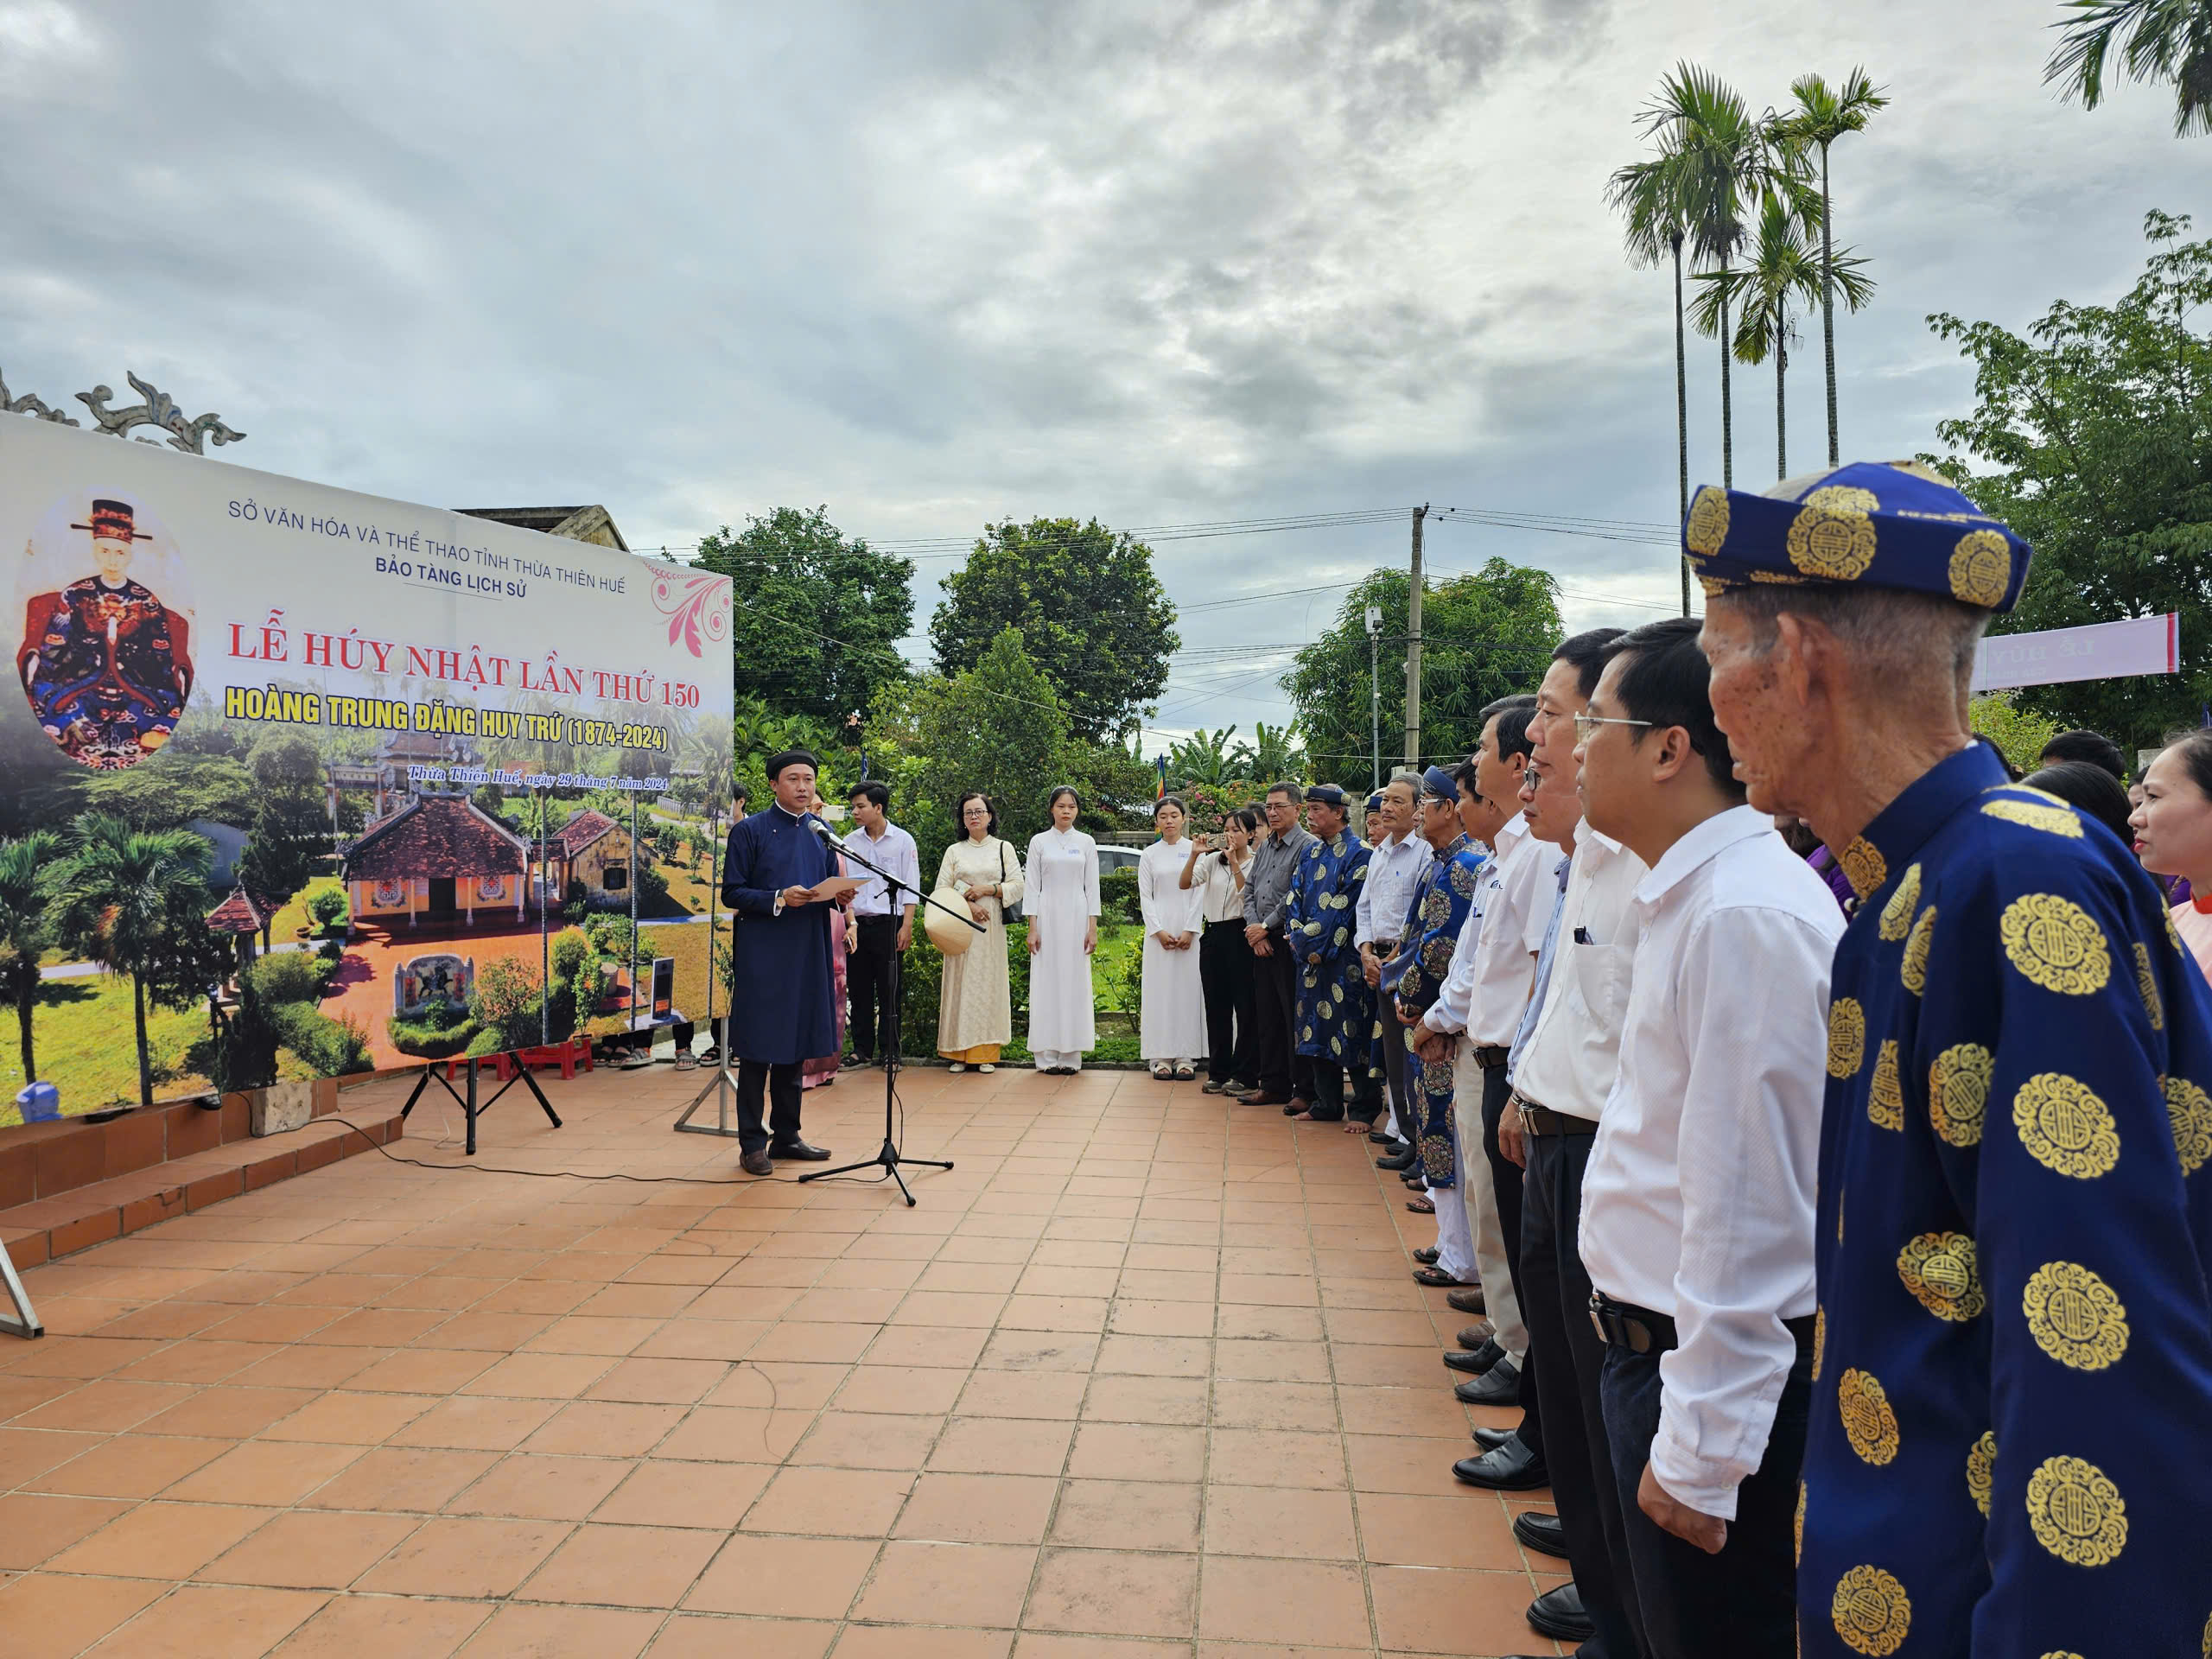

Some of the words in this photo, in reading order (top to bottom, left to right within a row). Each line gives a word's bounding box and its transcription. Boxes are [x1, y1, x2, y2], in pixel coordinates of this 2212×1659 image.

[228, 499, 257, 520] SỞ
[264, 507, 304, 530] VĂN
[311, 517, 350, 539] HÓA
[356, 525, 379, 544] VÀ
[386, 531, 420, 552] THỂ
[425, 540, 470, 562] THAO
[474, 547, 509, 570] TỈNH
[513, 558, 551, 580] THỪA
[556, 568, 595, 588] THIÊN
[600, 576, 626, 594] HUẾ
[376, 554, 412, 577] BẢO
[416, 563, 461, 586] TÀNG
[467, 574, 501, 594] LỊCH
[506, 580, 527, 598] SỬ
[228, 609, 288, 662] LỄ
[302, 628, 395, 673] HÚY
[405, 645, 509, 691] NHẬT
[519, 651, 583, 695] LẦN
[593, 669, 655, 703] THỨ
[662, 682, 700, 709] 150
[226, 683, 321, 724] HOÀNG
[327, 695, 409, 730] TRUNG
[414, 699, 476, 739] ĐẶNG
[481, 709, 521, 739] HUY
[525, 712, 564, 742] TRỨ
[567, 718, 668, 753] (1874-2024)
[408, 766, 445, 781] Thừa
[449, 767, 488, 782] Thiên
[491, 769, 524, 785] Huế,
[525, 772, 556, 786] ngày
[558, 774, 572, 785] 29
[574, 774, 607, 788] tháng
[611, 777, 618, 787] 7
[620, 778, 642, 789] năm
[645, 779, 668, 790] 2024
